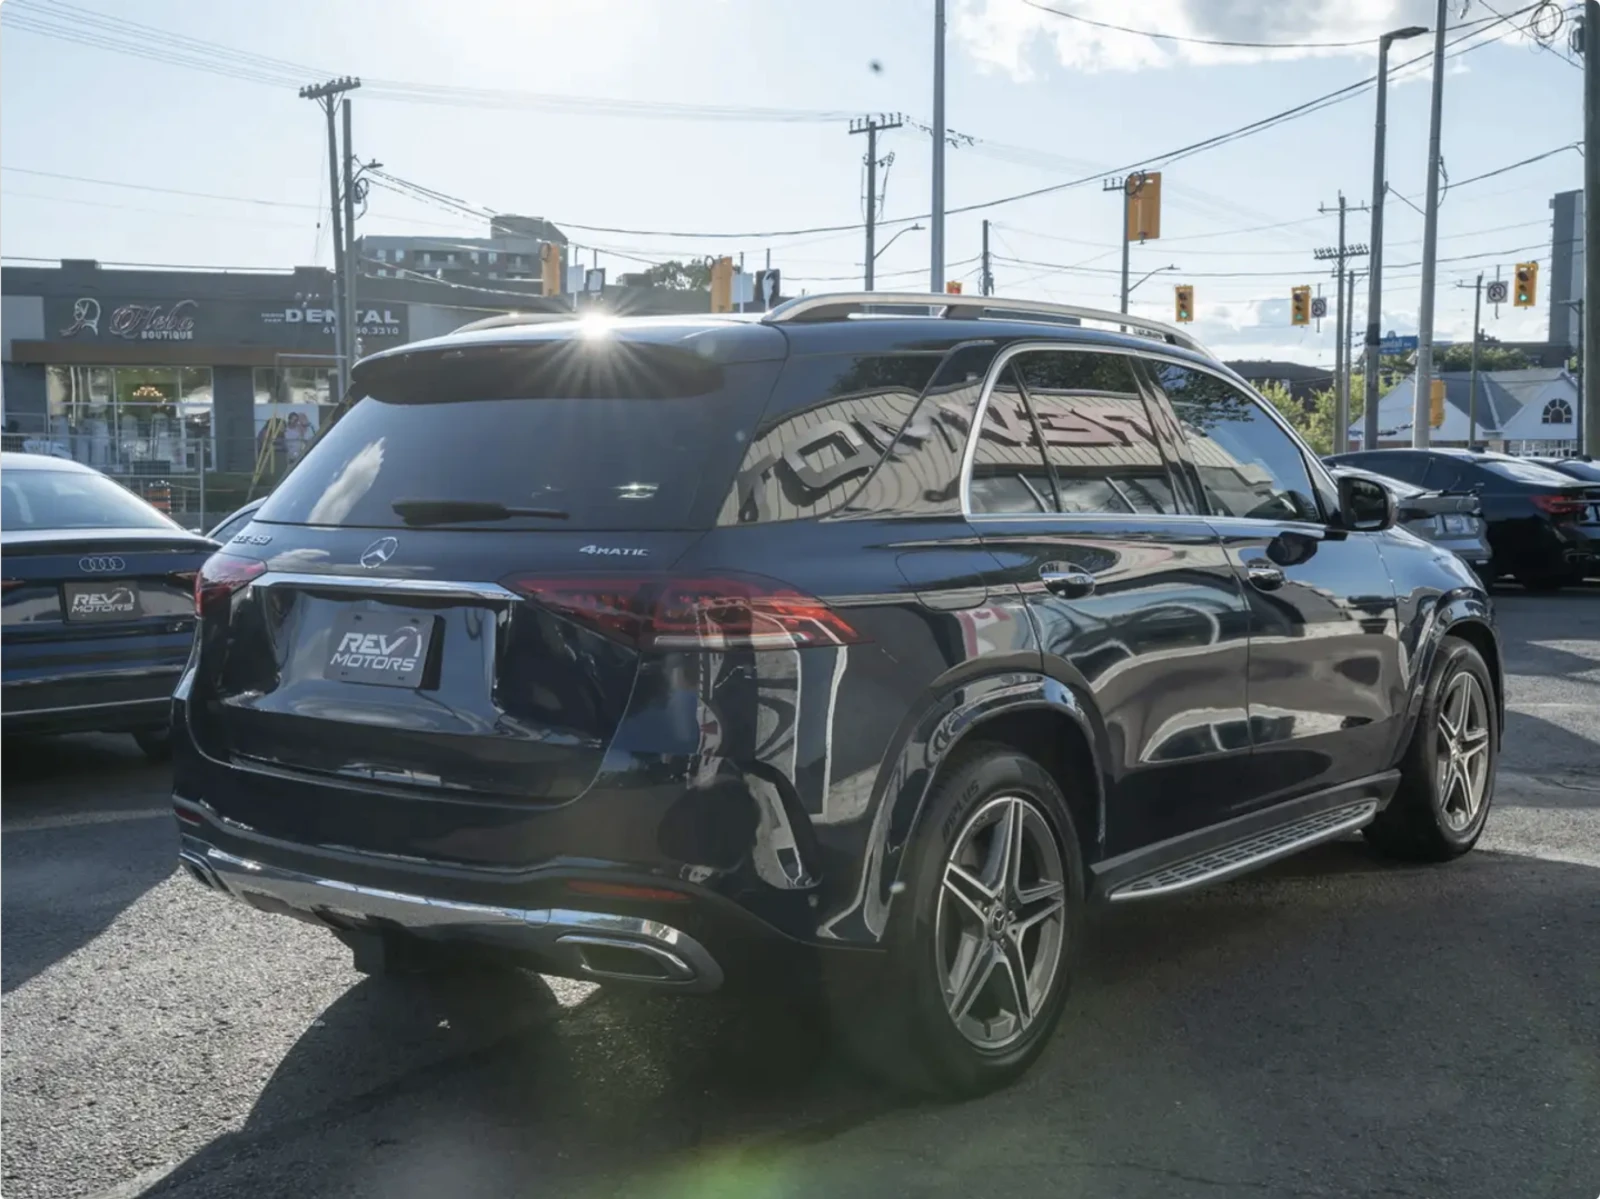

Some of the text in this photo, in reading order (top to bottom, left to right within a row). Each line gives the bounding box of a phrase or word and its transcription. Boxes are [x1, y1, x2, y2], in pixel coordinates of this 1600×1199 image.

[141, 330, 193, 340] BOUTIQUE
[579, 545, 650, 557] 4MATIC
[74, 592, 122, 605] REV
[71, 603, 134, 613] MOTORS
[337, 632, 408, 656] REV
[330, 652, 418, 672] MOTORS
